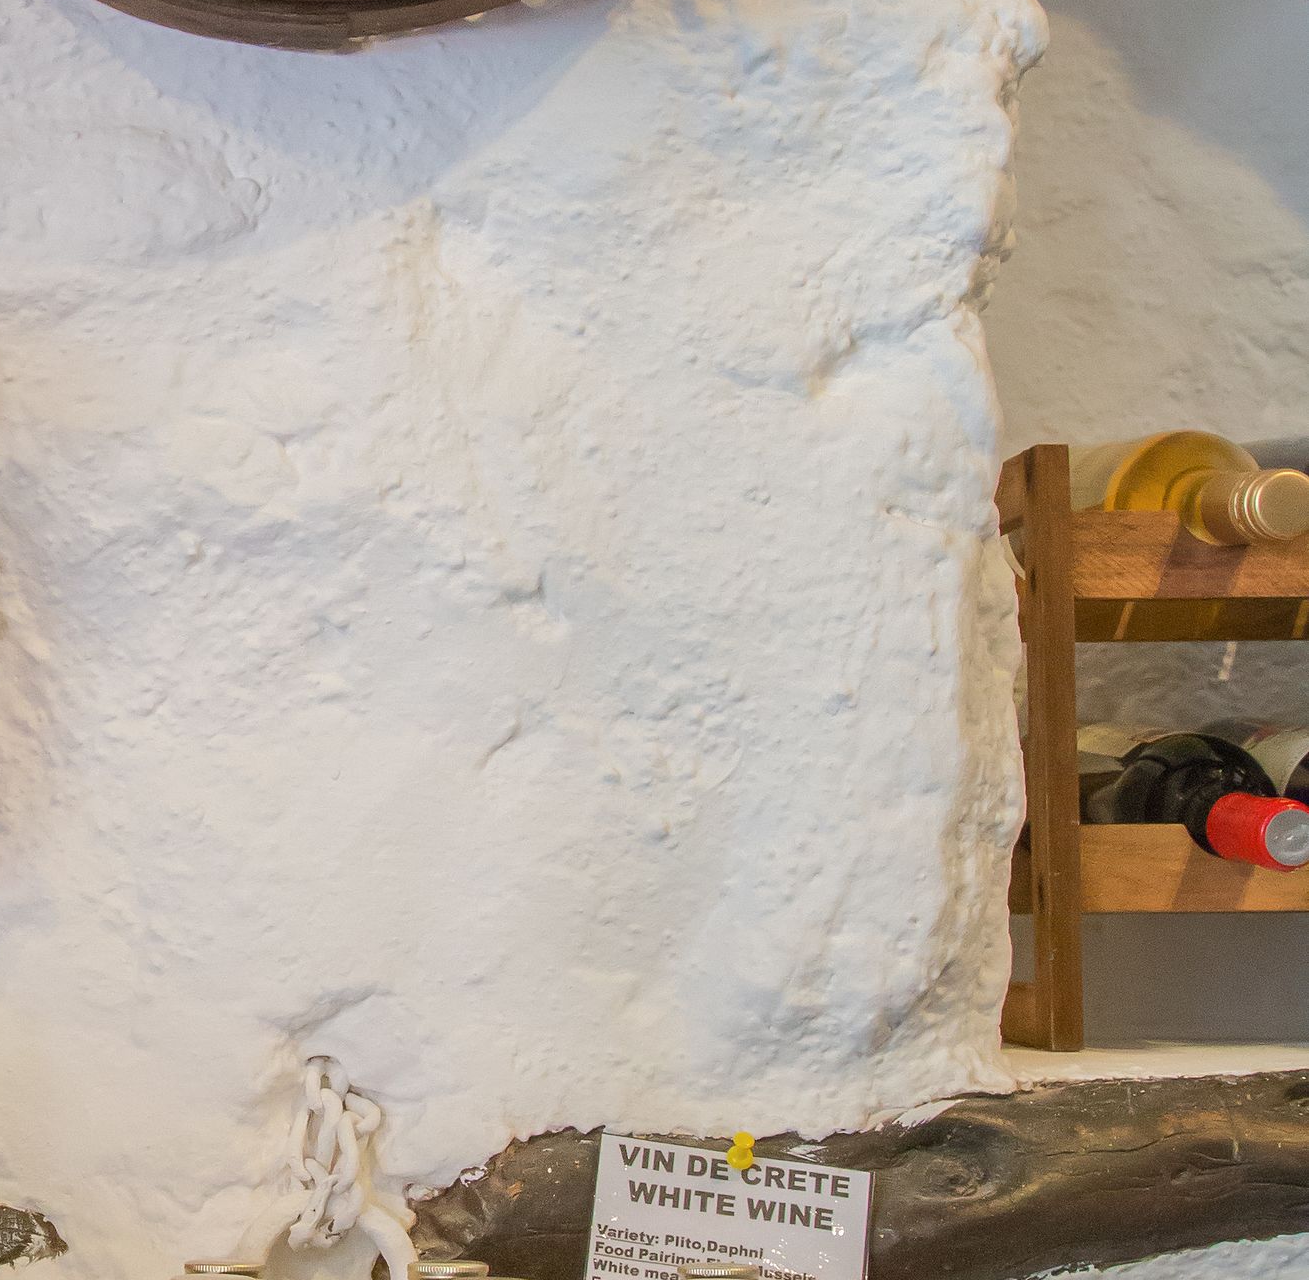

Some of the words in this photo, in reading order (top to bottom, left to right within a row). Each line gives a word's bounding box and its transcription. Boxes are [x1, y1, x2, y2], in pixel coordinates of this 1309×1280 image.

[619, 1144, 675, 1173] VIN
[687, 1155, 728, 1181] DE
[741, 1163, 850, 1198] CRETE
[629, 1180, 736, 1216] WHITE
[747, 1197, 834, 1231] WINE
[597, 1223, 659, 1246] Variety:
[595, 1241, 634, 1258] Food
[593, 1258, 640, 1277] White
